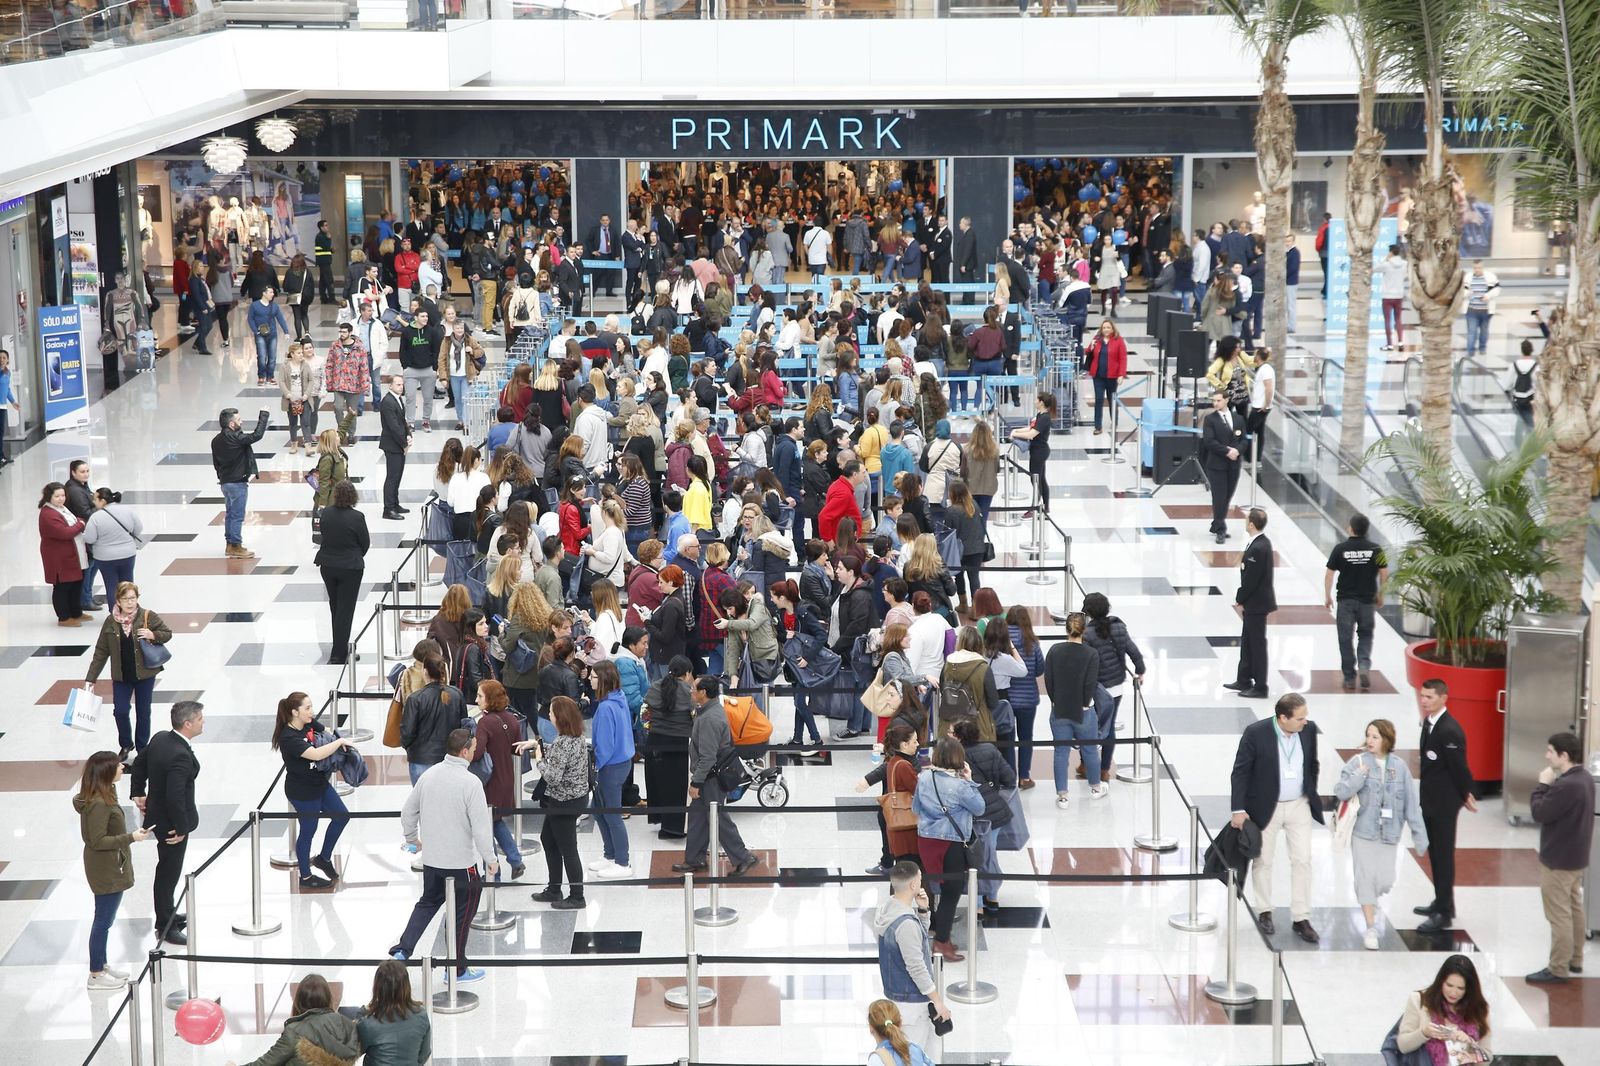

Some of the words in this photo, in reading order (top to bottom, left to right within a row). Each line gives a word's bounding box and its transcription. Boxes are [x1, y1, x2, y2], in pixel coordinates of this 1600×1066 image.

[672, 118, 902, 150] PRIMARK
[43, 316, 60, 327] SÓLO
[62, 313, 77, 325] AQUÍ
[46, 341, 67, 350] Galaxy
[1343, 550, 1373, 559] CREW
